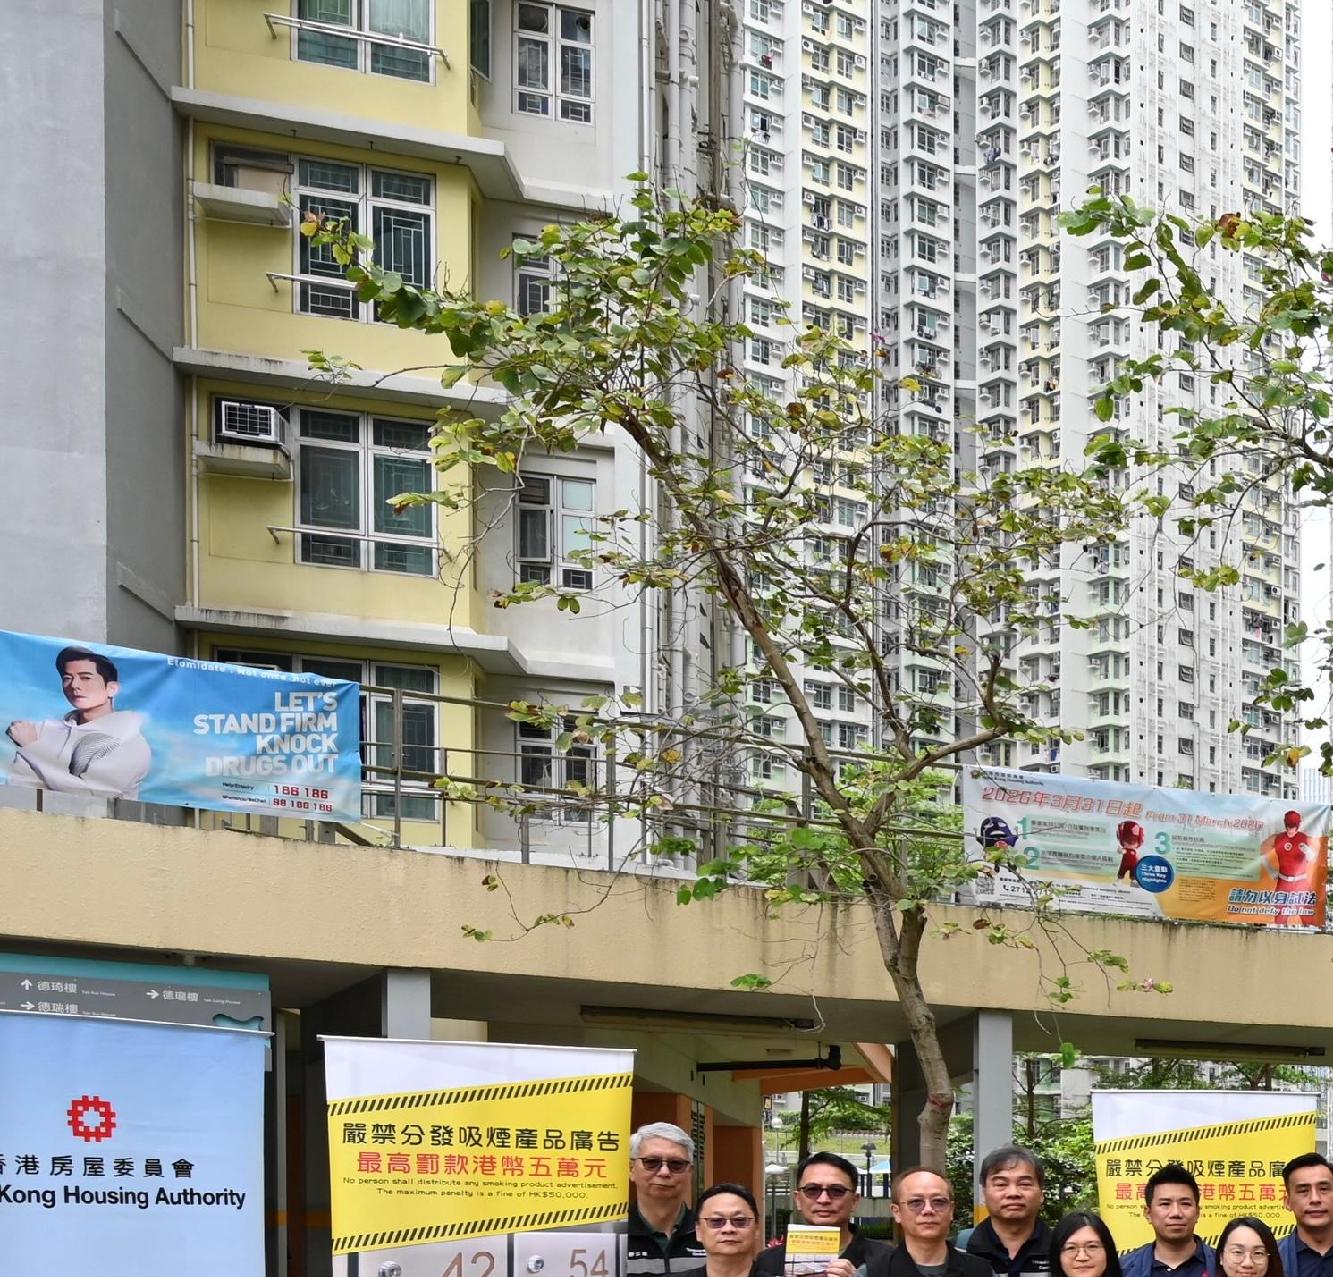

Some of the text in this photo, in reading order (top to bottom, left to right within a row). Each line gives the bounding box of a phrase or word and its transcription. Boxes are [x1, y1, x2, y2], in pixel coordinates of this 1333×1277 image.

[275, 691, 337, 712] LET'S
[193, 711, 337, 735] STAND FIRM
[256, 732, 339, 755] KNOCK
[205, 753, 339, 777] DRUGS OUT
[342, 1122, 621, 1152] 嚴禁分發吸煙產品廣告
[357, 1151, 608, 1179] 最高罰款港幣五萬元
[358, 1178, 518, 1189] person smoking
[0, 1184, 246, 1210] Kong Housing Authority
